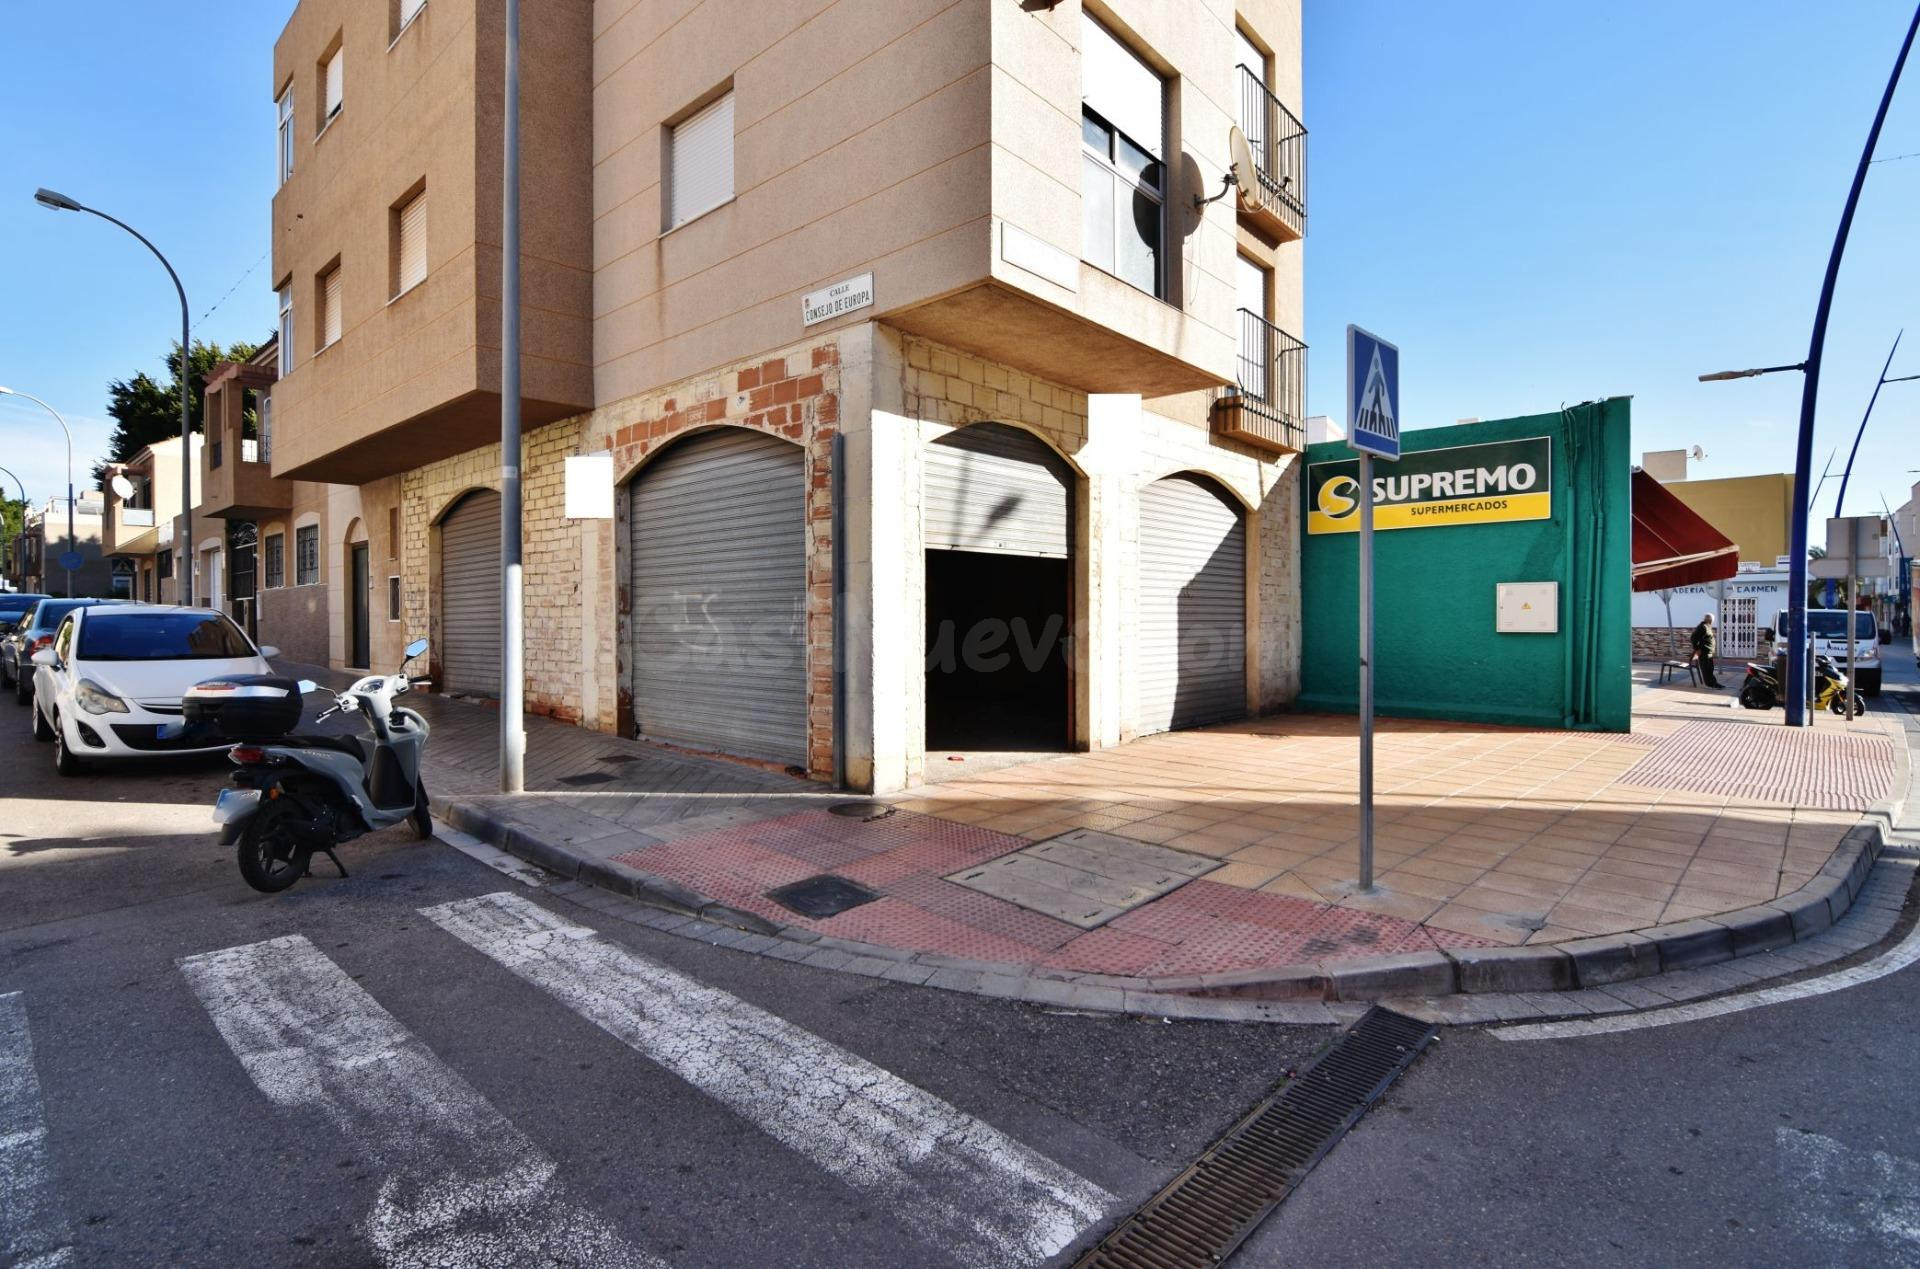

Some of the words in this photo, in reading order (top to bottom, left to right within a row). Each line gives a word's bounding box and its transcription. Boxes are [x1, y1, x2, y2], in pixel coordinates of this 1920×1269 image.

[829, 284, 850, 297] CALLE
[805, 303, 833, 321] CONSEJO
[834, 299, 843, 311] DE
[844, 290, 870, 308] EUROPA
[1372, 462, 1537, 503] SUPREMO
[1411, 500, 1508, 515] SUPERMERCADOS
[1736, 585, 1778, 593] CARMEN
